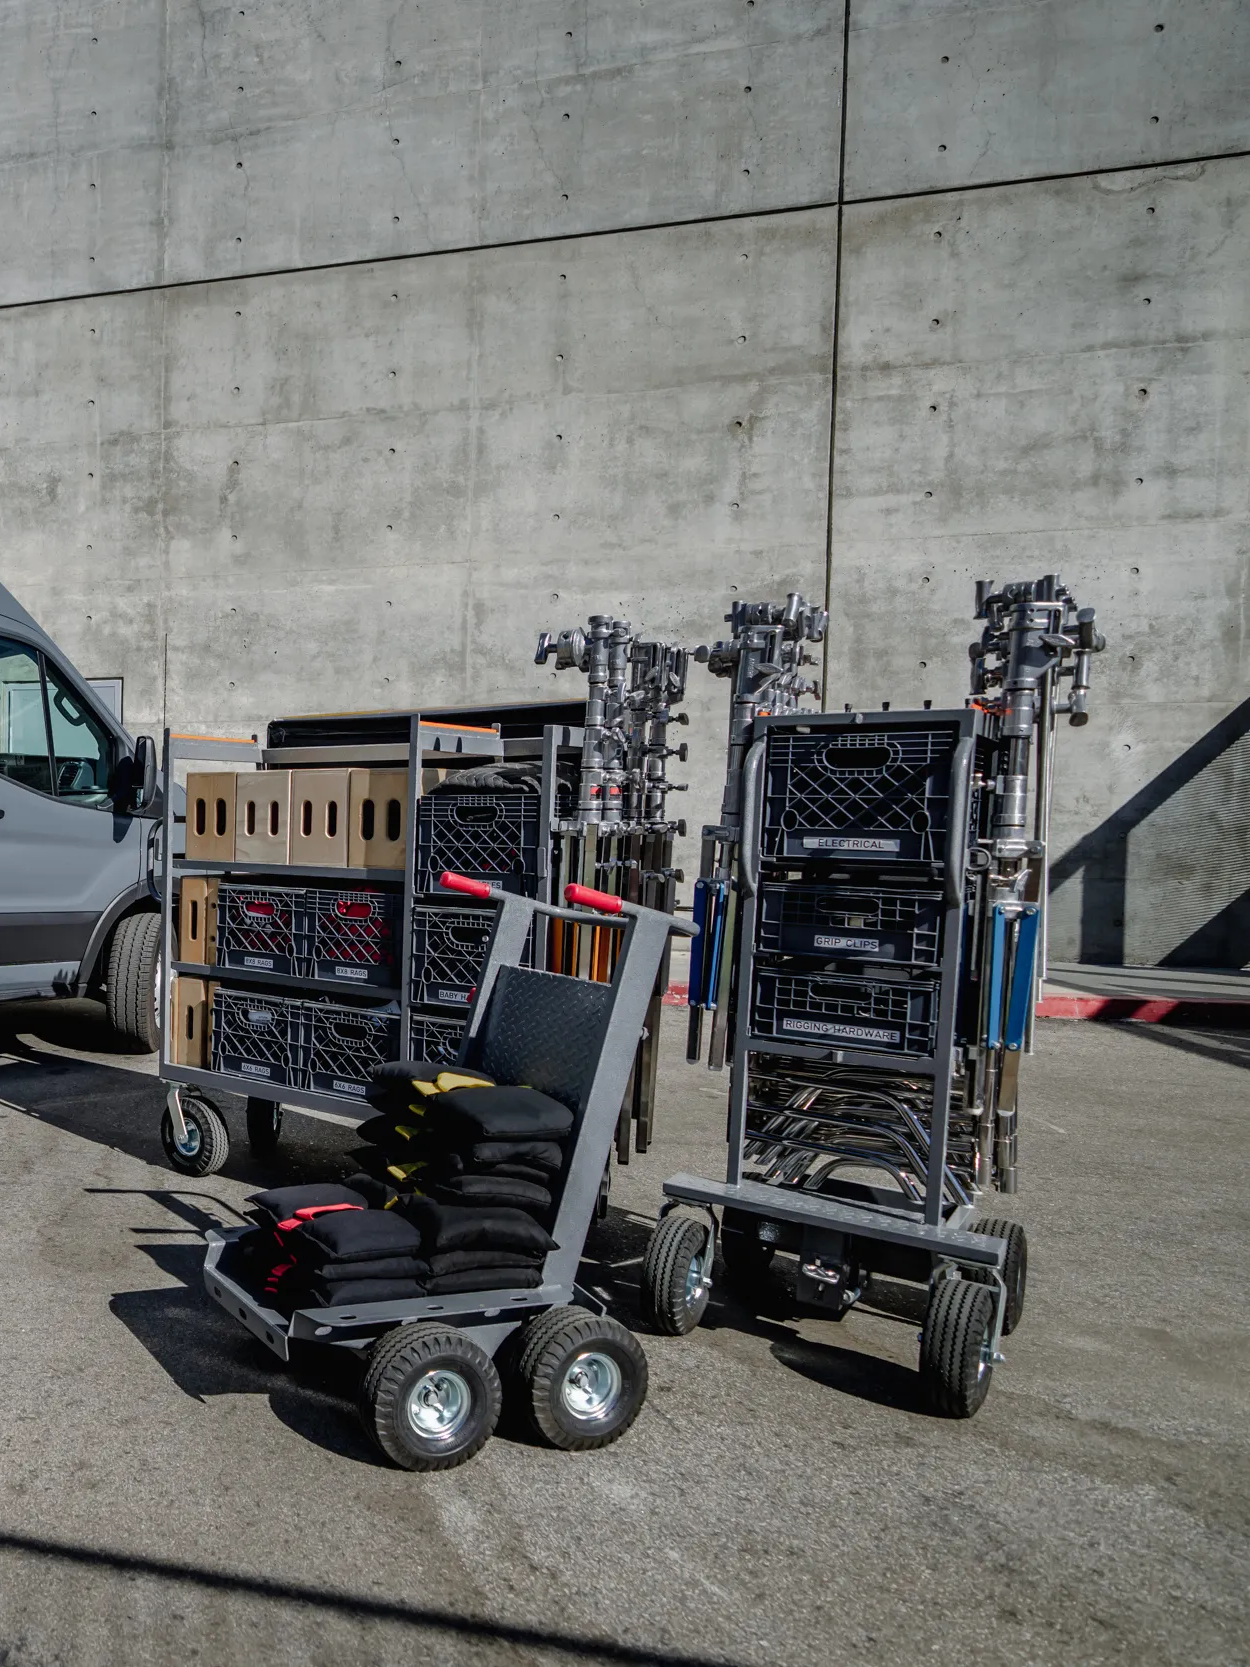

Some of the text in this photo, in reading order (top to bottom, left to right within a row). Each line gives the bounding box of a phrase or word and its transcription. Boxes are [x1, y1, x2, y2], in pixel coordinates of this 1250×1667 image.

[818, 838, 884, 849] ELECTRICAL
[816, 937, 878, 949] GRIP CLIPS
[257, 959, 273, 967] RAGS
[350, 969, 367, 978] RAGS
[439, 991, 458, 1000] BABY
[785, 1020, 898, 1040] RIGGING HARDWARE
[242, 1063, 270, 1075] 6X6 RAGS
[334, 1081, 365, 1094] 6X6 RAGS
